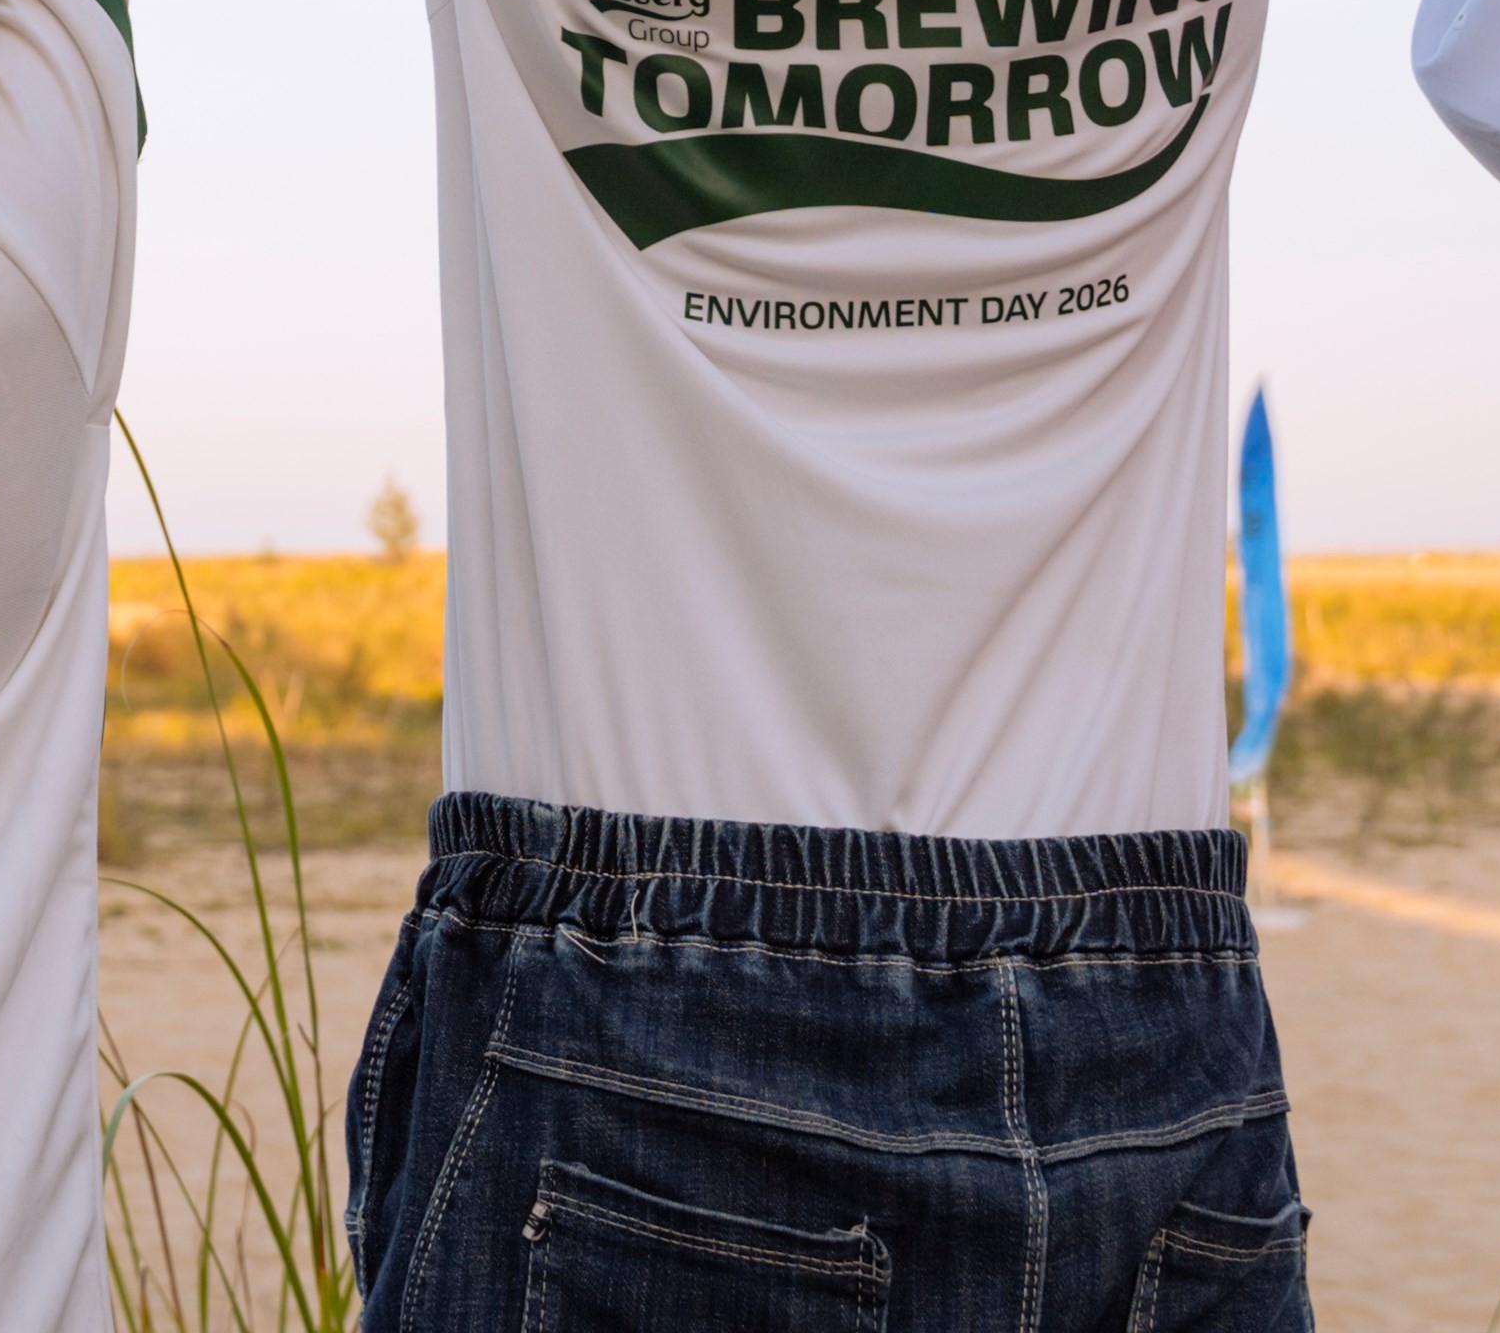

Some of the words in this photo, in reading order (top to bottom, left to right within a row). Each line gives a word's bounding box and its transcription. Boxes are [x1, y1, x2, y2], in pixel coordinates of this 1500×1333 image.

[628, 19, 710, 52] Group
[561, 1, 1233, 147] TOMORROW
[684, 292, 969, 331] ENVIRONMENT
[981, 291, 1048, 325] DAY
[1058, 274, 1130, 317] 2026
